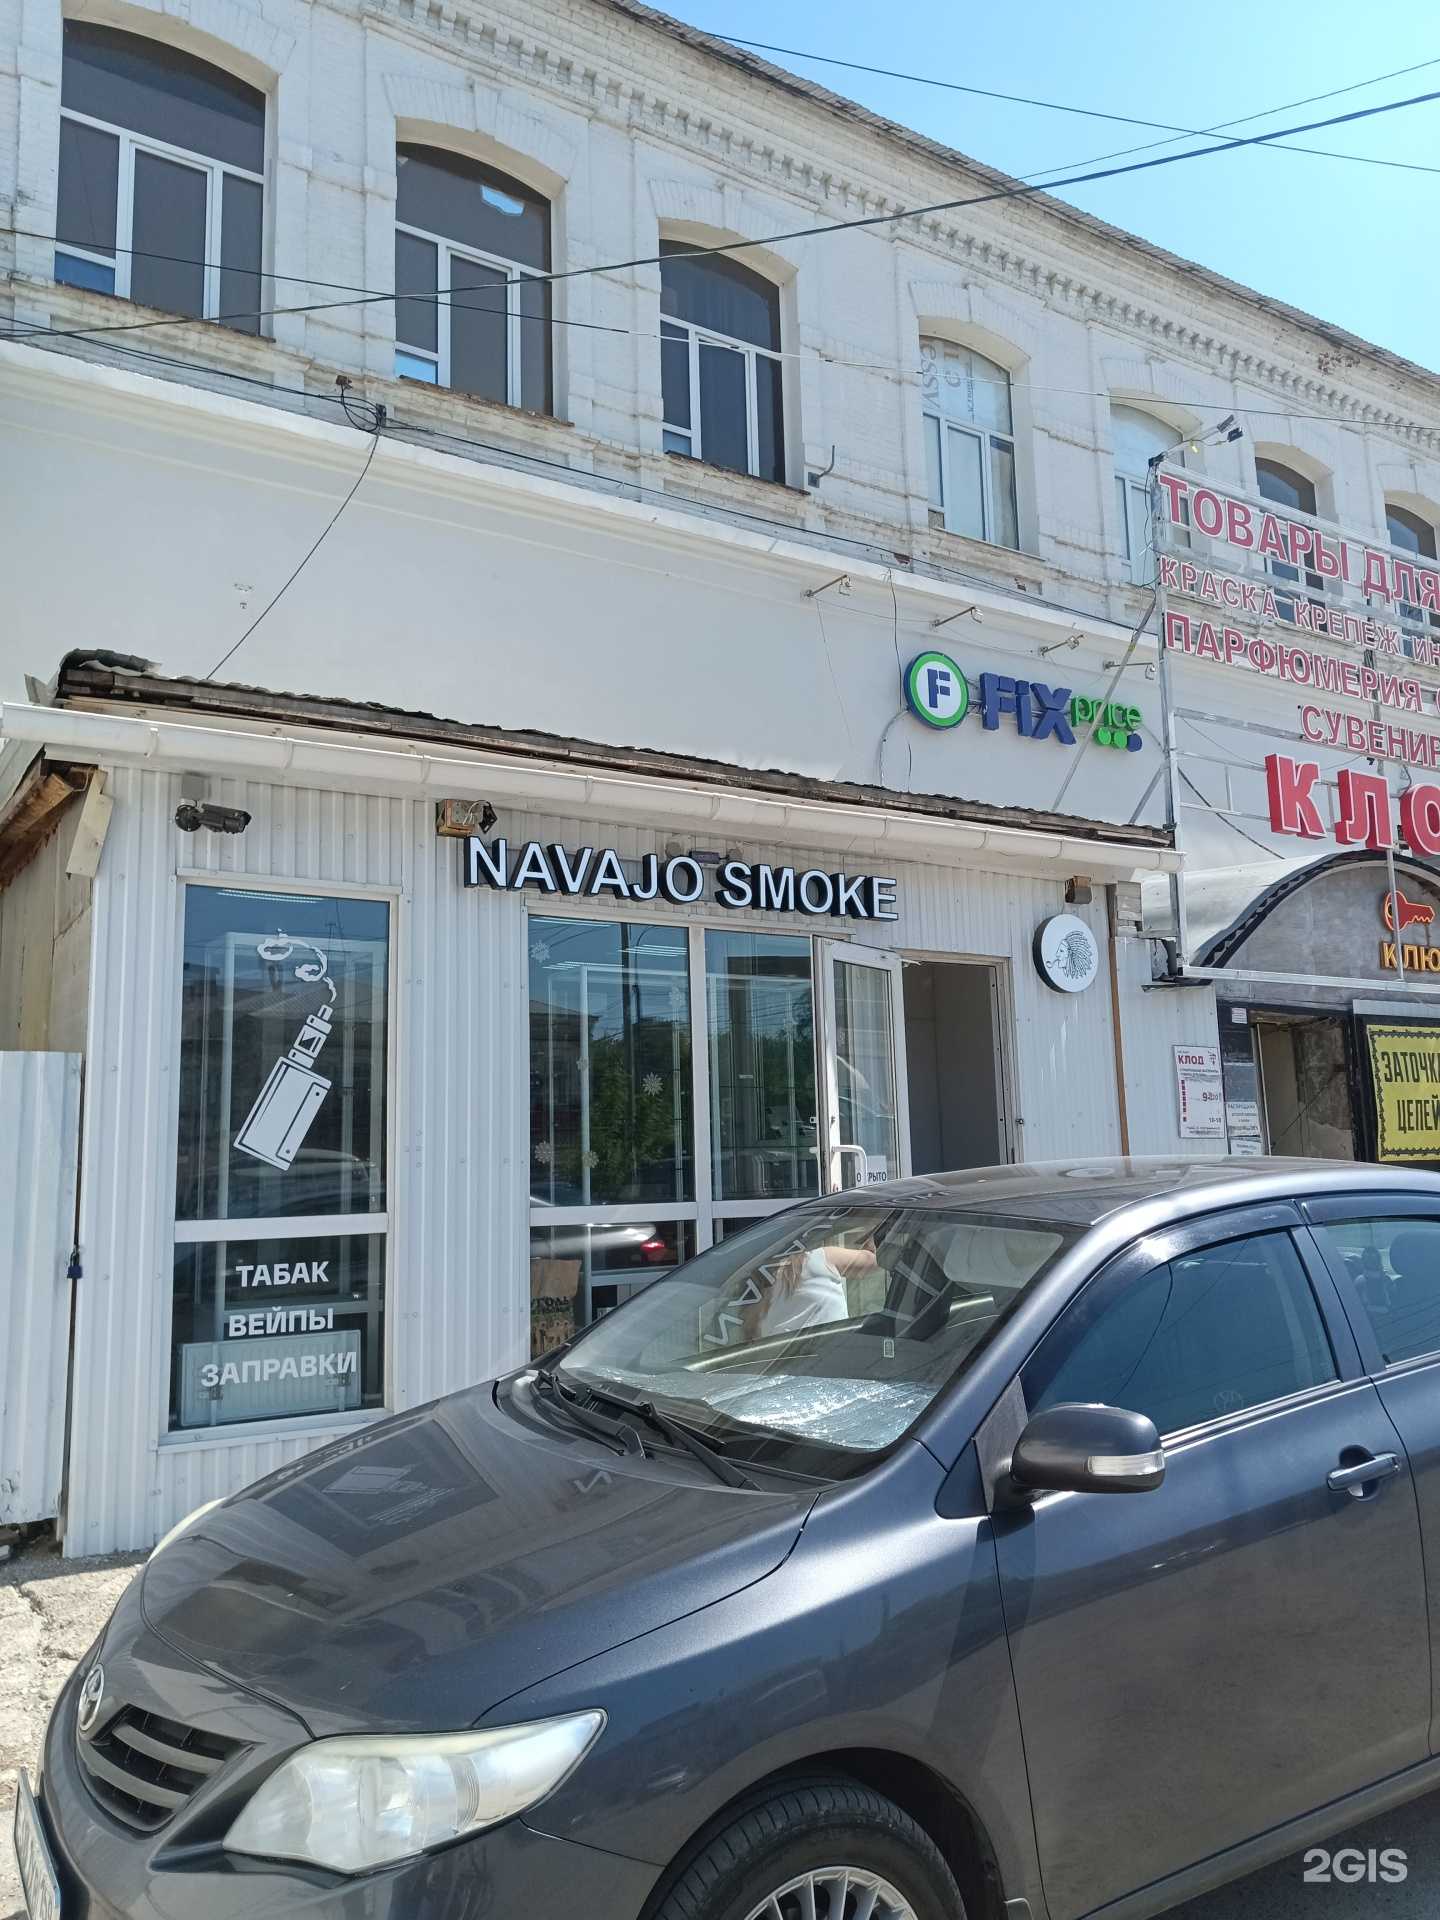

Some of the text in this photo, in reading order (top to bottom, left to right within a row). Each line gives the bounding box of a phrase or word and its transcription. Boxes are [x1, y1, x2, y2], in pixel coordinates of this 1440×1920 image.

[1158, 474, 1440, 614] ТОВАРЫ ДЛЯ
[1160, 555, 1280, 620] КРАСКА
[1294, 598, 1400, 656] КРЕПЕЖ
[1165, 611, 1423, 712] ПАРФЮМЕРИЯ
[464, 836, 899, 921] NAVAJO SMOKE
[1380, 1051, 1440, 1083] ЗАТОЧК
[856, 1171, 887, 1182] ОРЫТО
[235, 1261, 329, 1288] ТАБАК
[228, 1305, 334, 1337] ВЕЙПЫ
[200, 1350, 357, 1388] ЗАПРАВКИ
